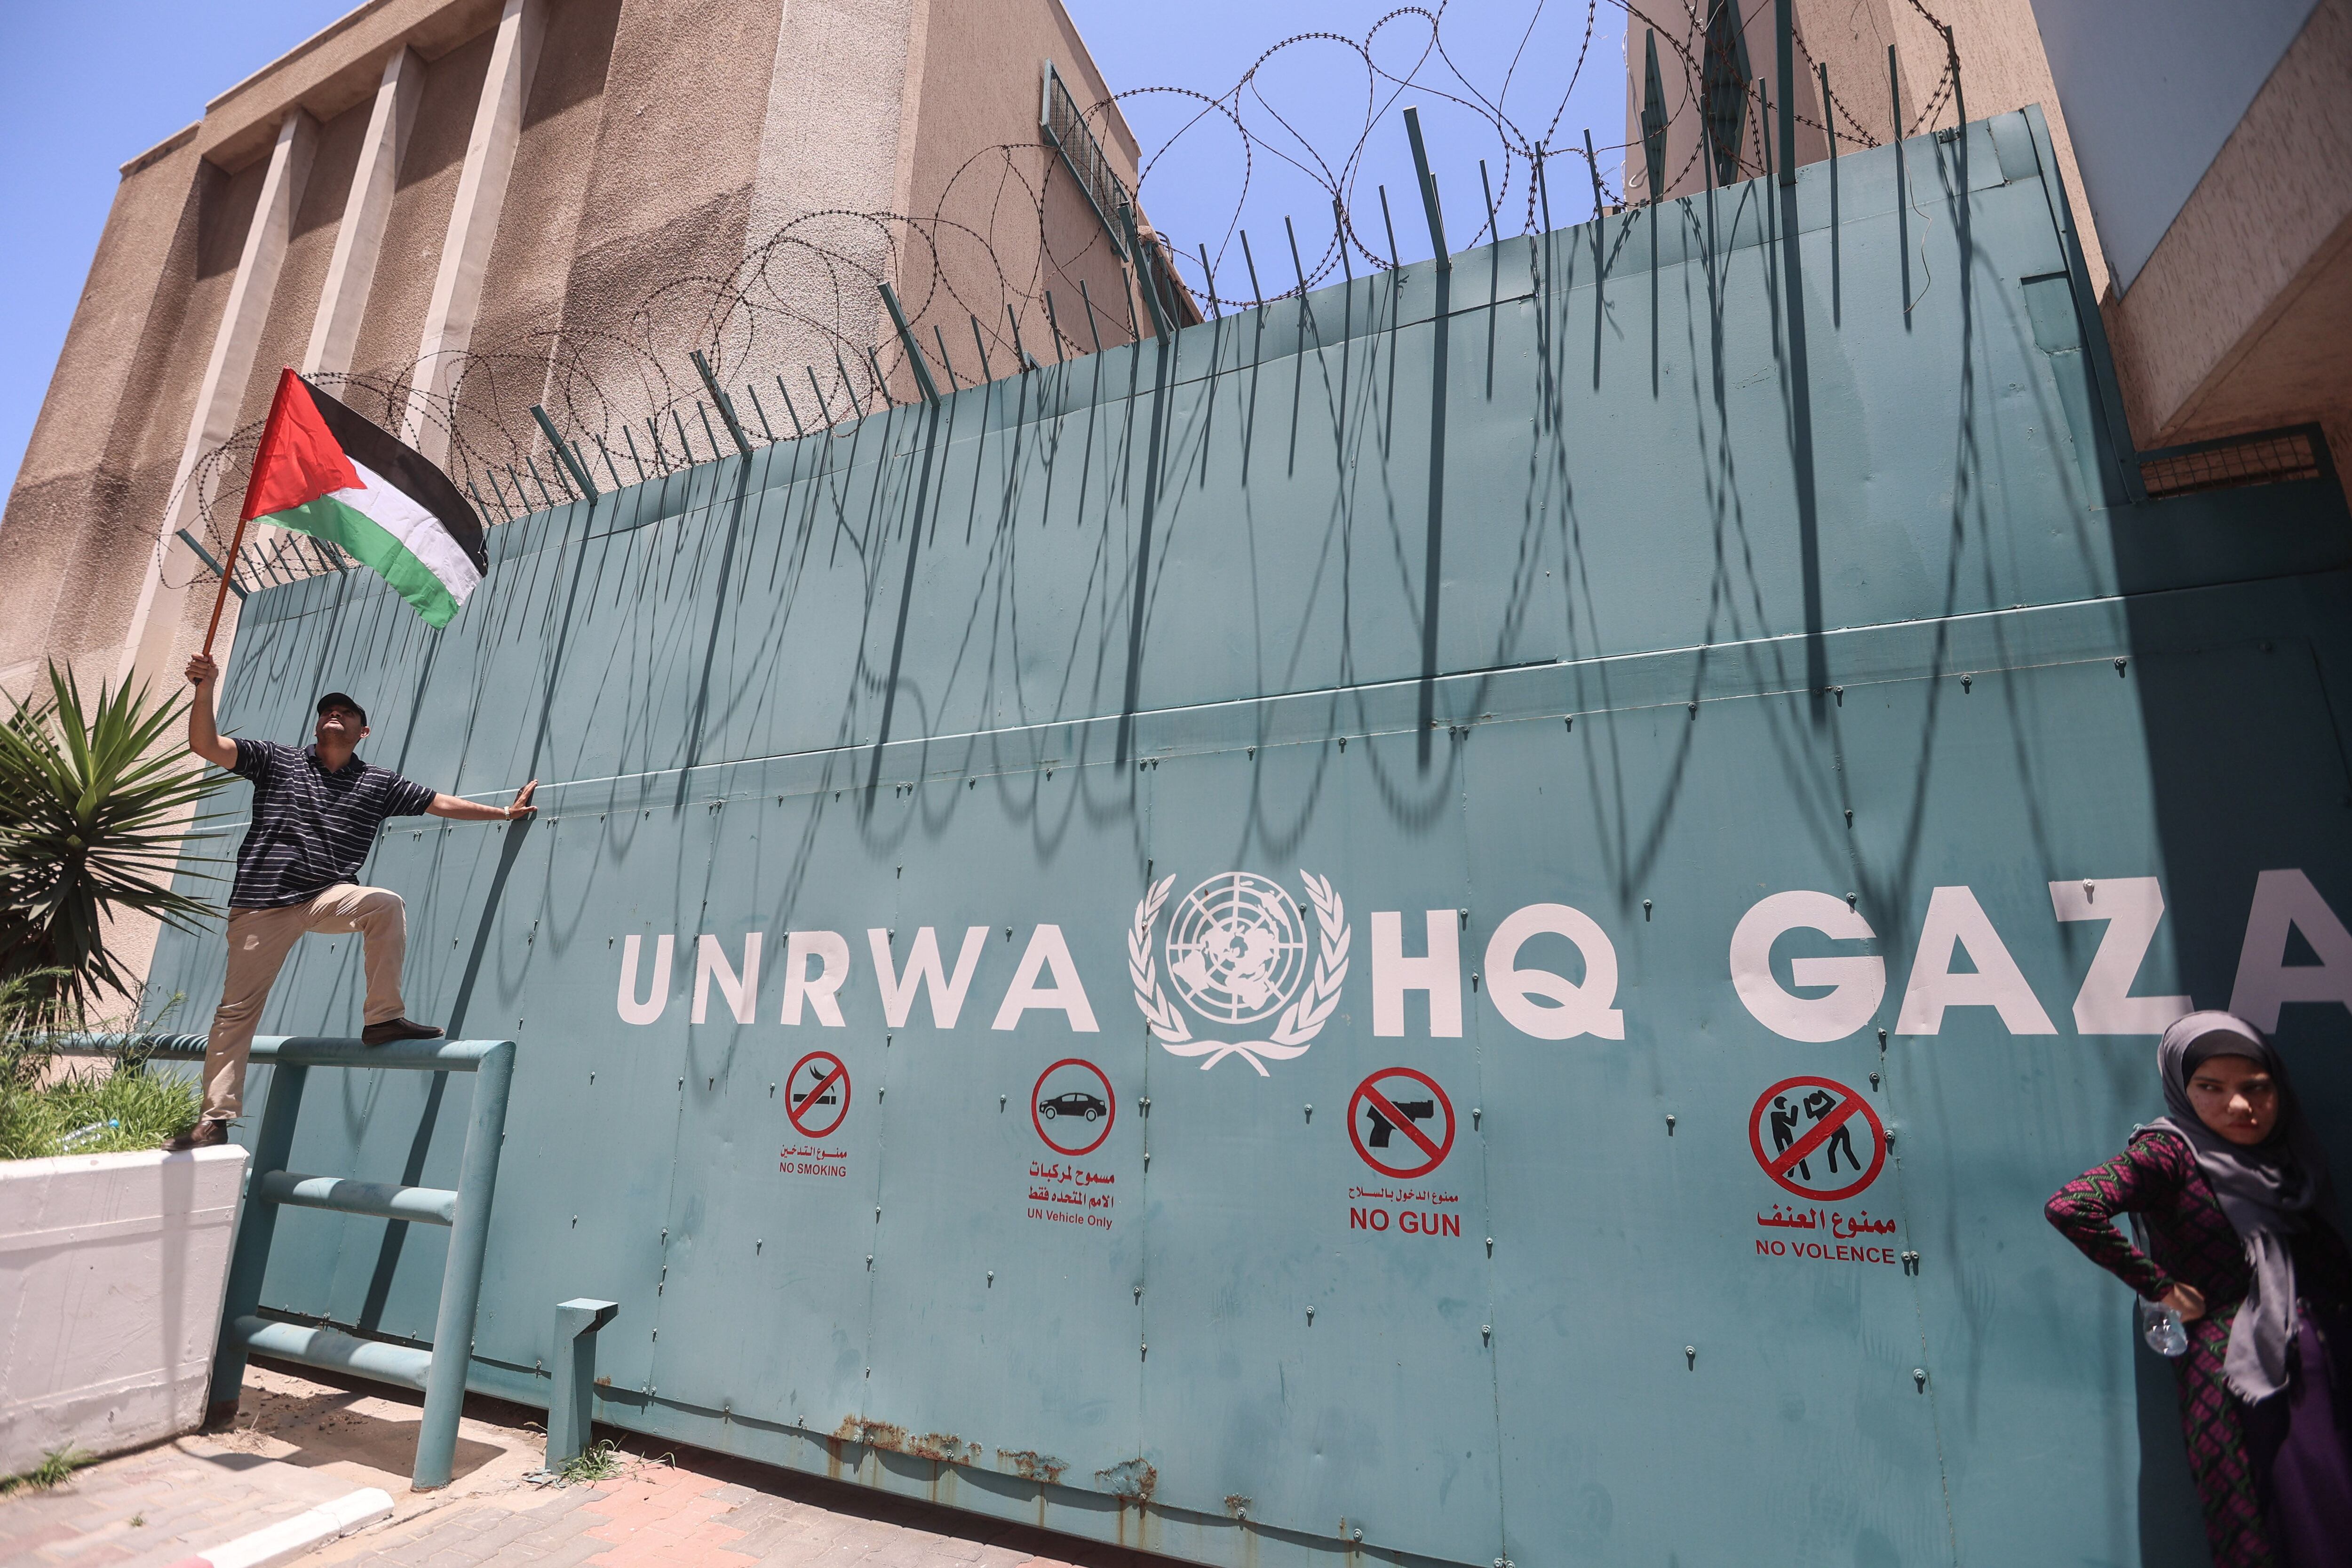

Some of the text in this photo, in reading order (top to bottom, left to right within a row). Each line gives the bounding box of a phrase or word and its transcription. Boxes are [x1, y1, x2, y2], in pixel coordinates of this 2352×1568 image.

[617, 868, 2352, 1043] UNRWA HQ GAZA
[780, 1145, 847, 1161] ممنوع التدخين
[779, 1162, 846, 1177] NO SMOKING
[1075, 1170, 1114, 1186] مسموح
[1028, 1186, 1049, 1201] فقط
[1349, 1186, 1459, 1205] ممنوع الدخول بالسلاح
[1027, 1208, 1112, 1230] UN Vehicle Only
[1351, 1207, 1460, 1237] NO GUN
[1757, 1203, 1896, 1239] ممنوع العنف
[1756, 1240, 1896, 1264] NO VOLENCE
